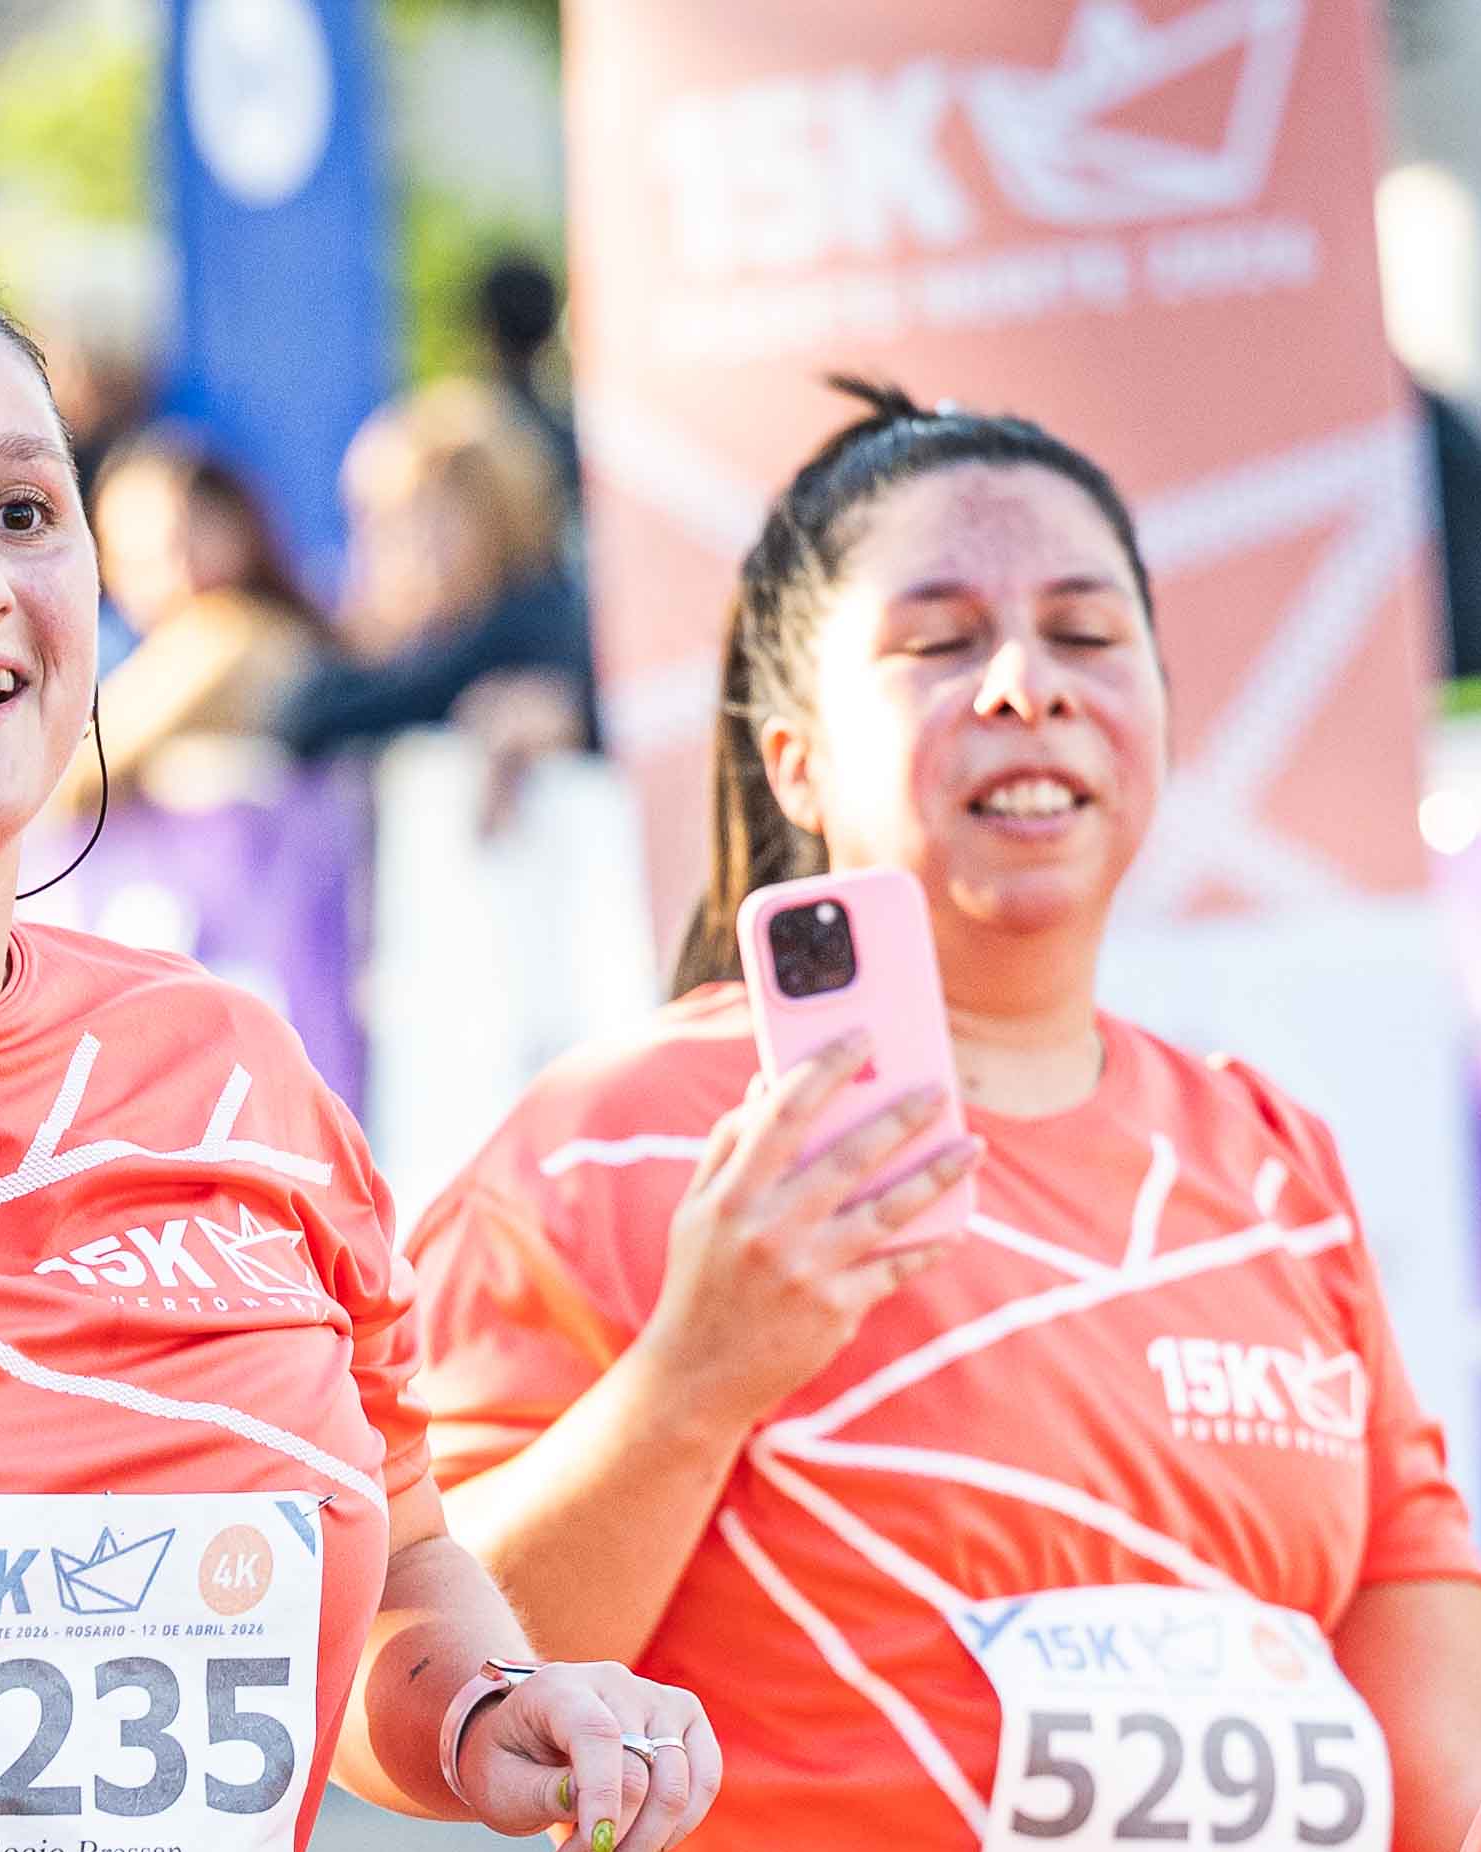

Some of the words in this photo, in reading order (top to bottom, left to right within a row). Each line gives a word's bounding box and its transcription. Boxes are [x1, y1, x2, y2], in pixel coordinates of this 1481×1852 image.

[33, 1218, 217, 1288] 15K
[1147, 1336, 1285, 1421] 15K
[211, 1553, 259, 1591] 4K
[16, 1625, 49, 1639] 2026
[65, 1625, 125, 1638] ROSARIO
[142, 1625, 157, 1637] 12
[162, 1625, 179, 1637] DE
[185, 1624, 225, 1637] ABRIL
[230, 1623, 265, 1636] 2026
[1023, 1624, 1132, 1672] 15K
[1009, 1710, 1365, 1847] 5295
